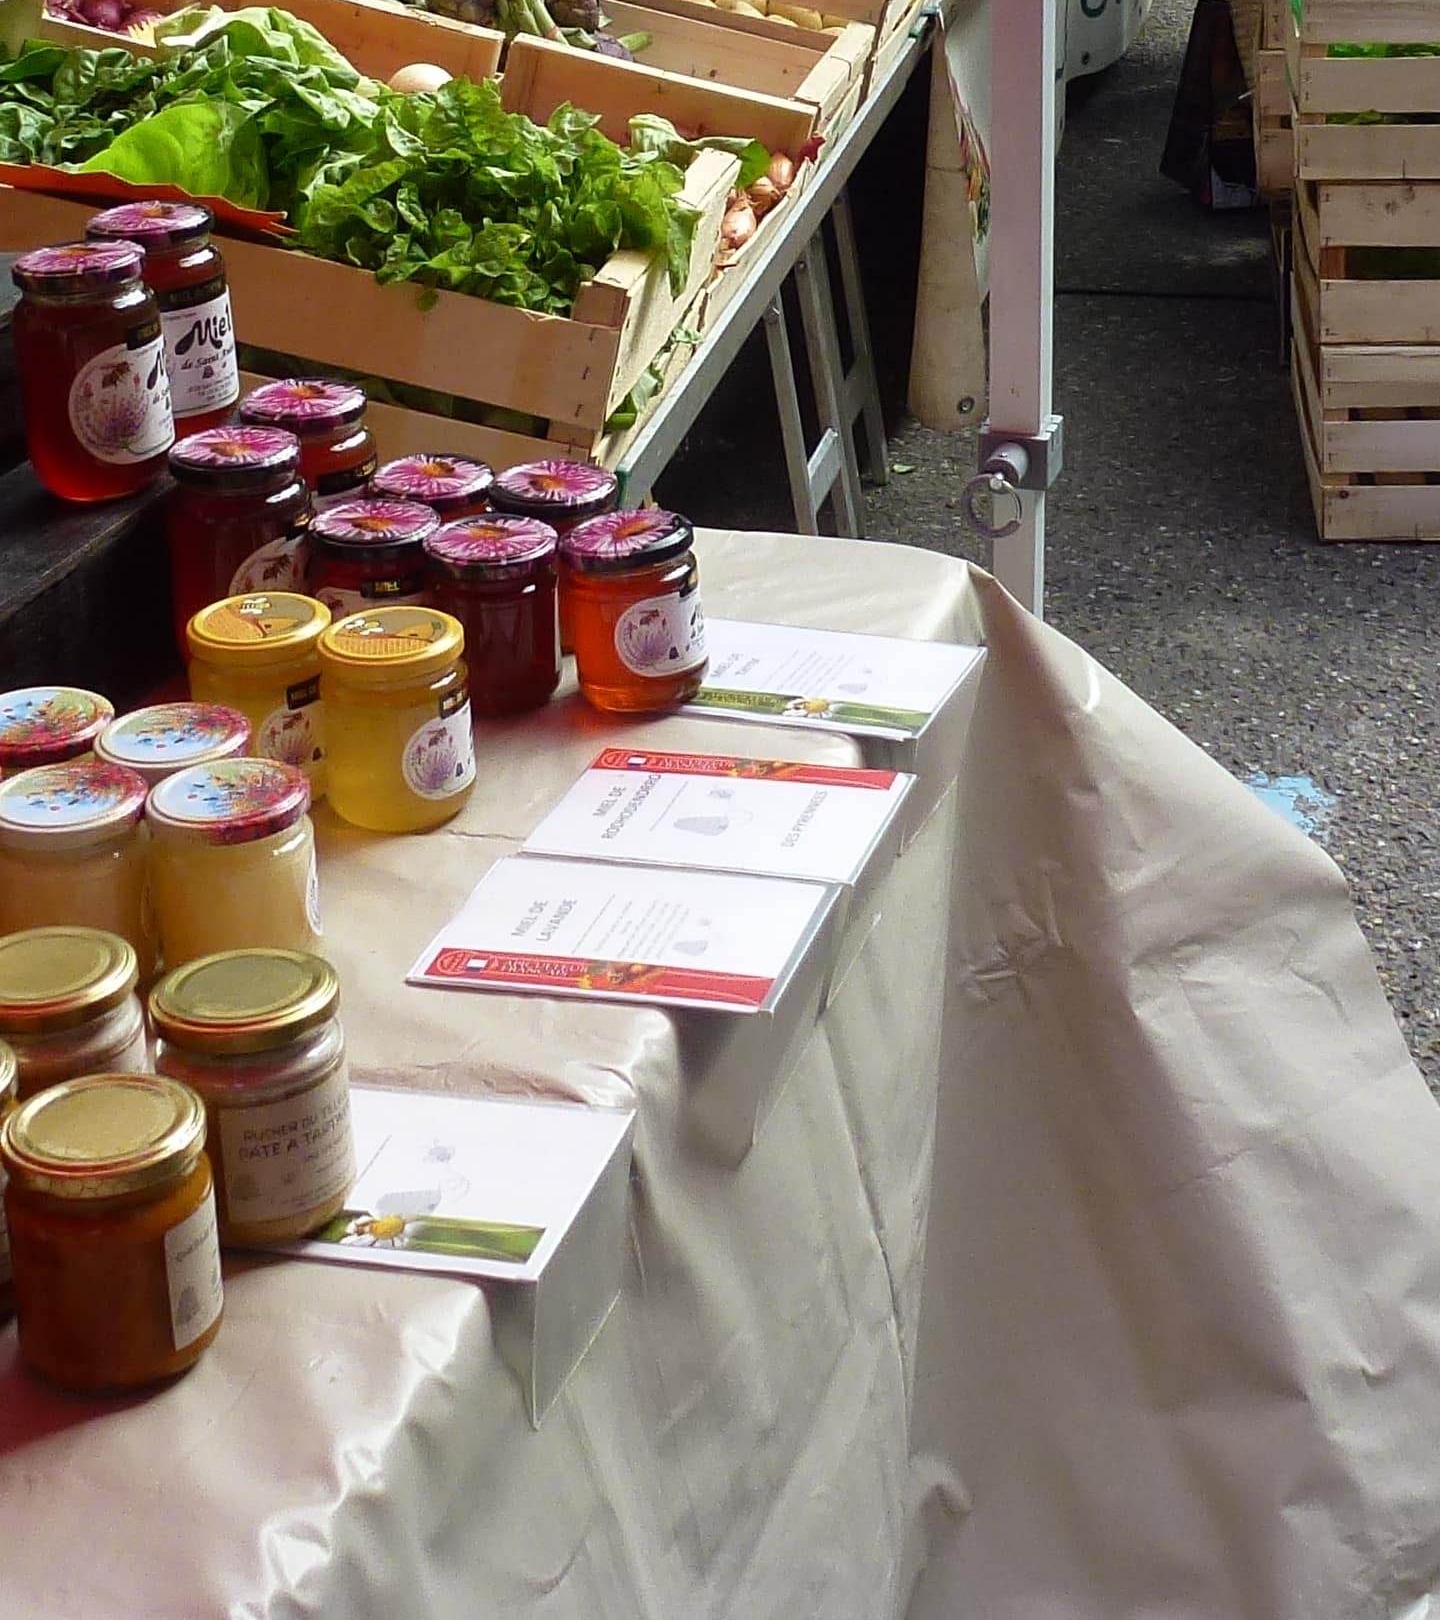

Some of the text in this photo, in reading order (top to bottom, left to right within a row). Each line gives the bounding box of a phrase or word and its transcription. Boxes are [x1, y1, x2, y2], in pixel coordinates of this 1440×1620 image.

[174, 302, 231, 355] Miel
[593, 785, 627, 819] MIEL DE
[511, 899, 549, 938] MIEL DE
[537, 898, 578, 943] LAVANDE
